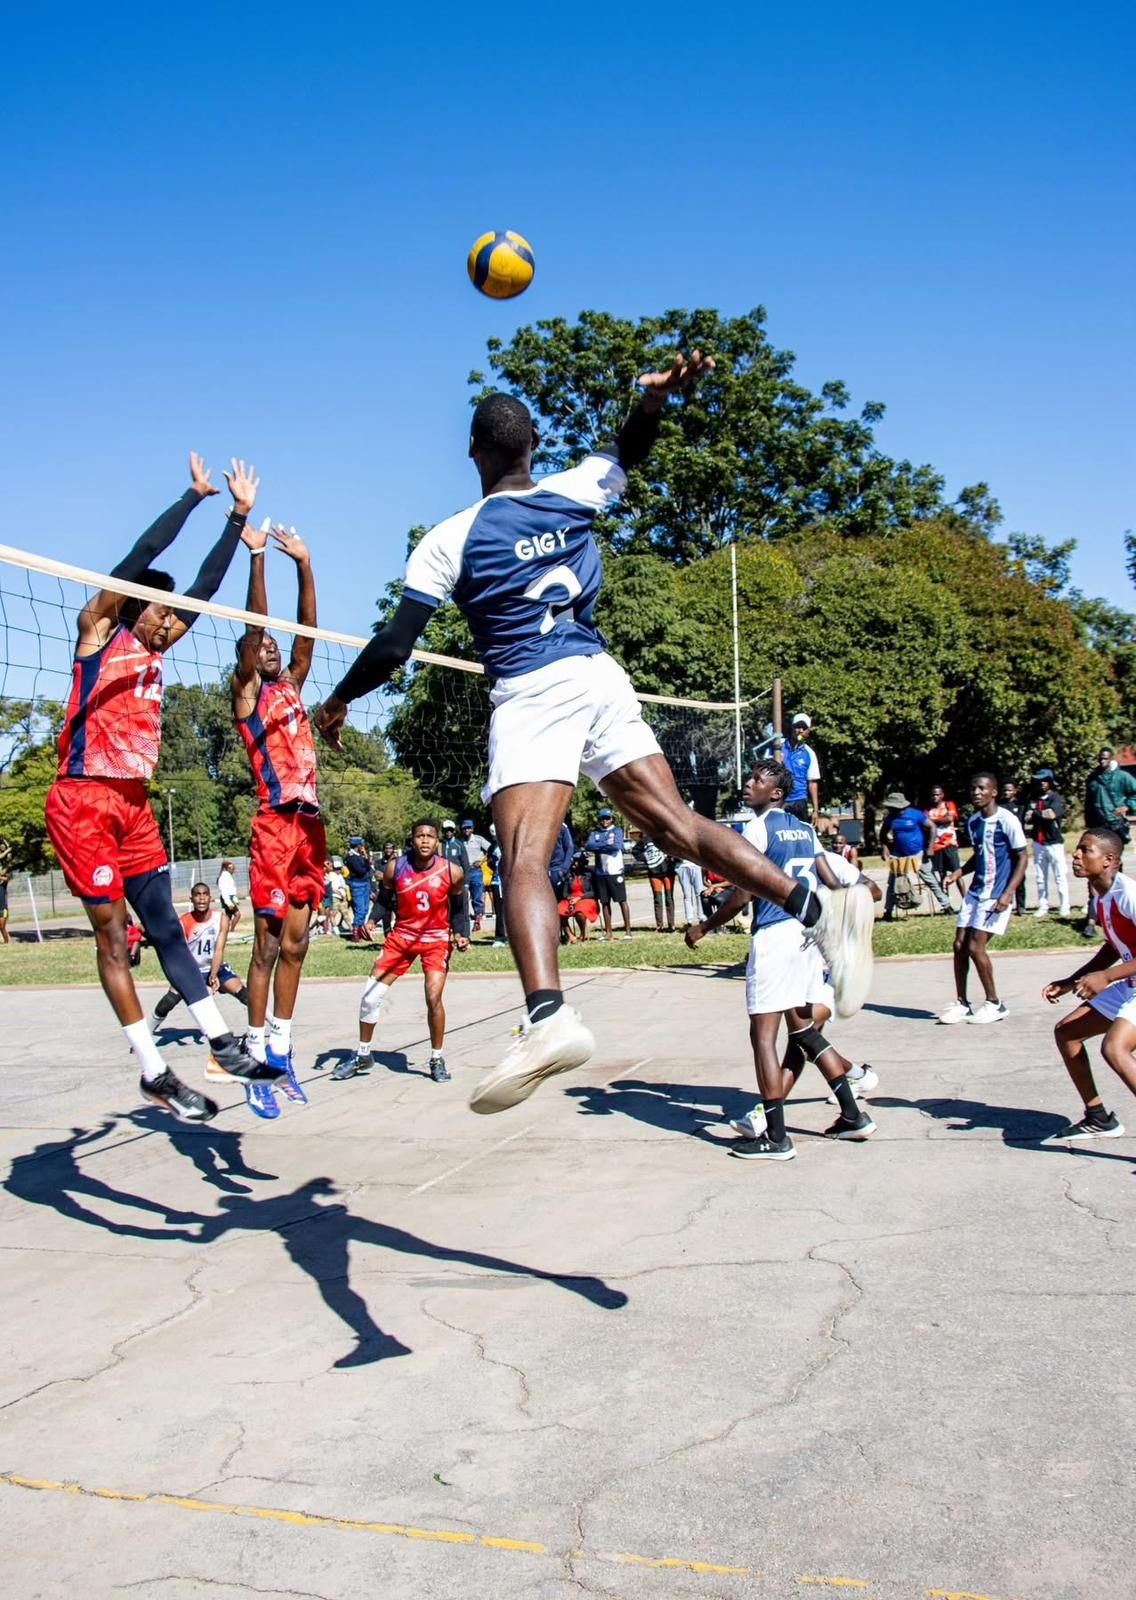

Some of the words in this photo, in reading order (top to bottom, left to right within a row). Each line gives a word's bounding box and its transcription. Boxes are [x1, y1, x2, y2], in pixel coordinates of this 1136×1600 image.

[514, 527, 571, 561] GIGY
[133, 659, 162, 702] 12
[415, 890, 430, 912] 3
[197, 939, 211, 955] 14
